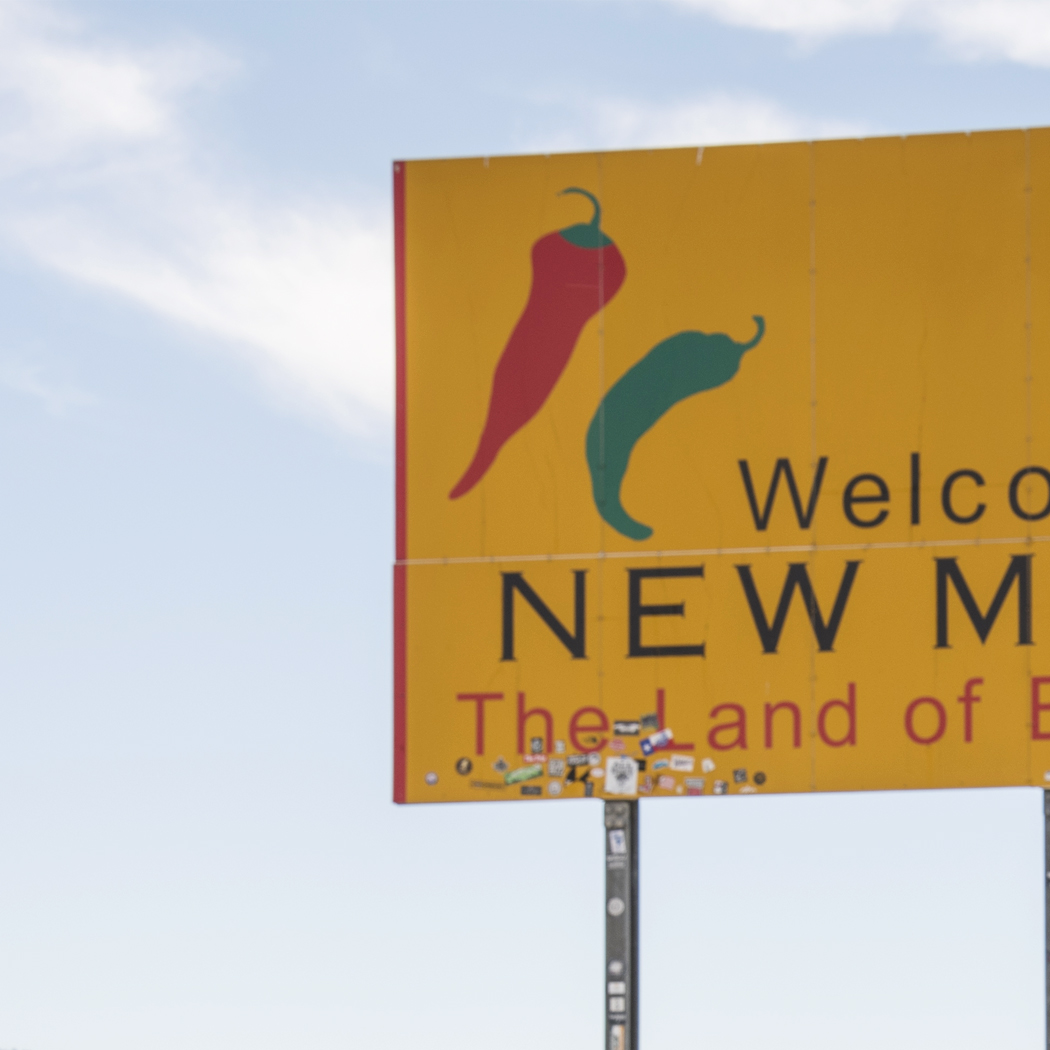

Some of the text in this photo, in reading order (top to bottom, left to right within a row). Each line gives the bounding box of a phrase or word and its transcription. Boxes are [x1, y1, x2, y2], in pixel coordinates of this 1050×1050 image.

[501, 560, 860, 661] NEW
[456, 691, 611, 756] The
[653, 682, 857, 753] Land
[904, 677, 984, 746] of
